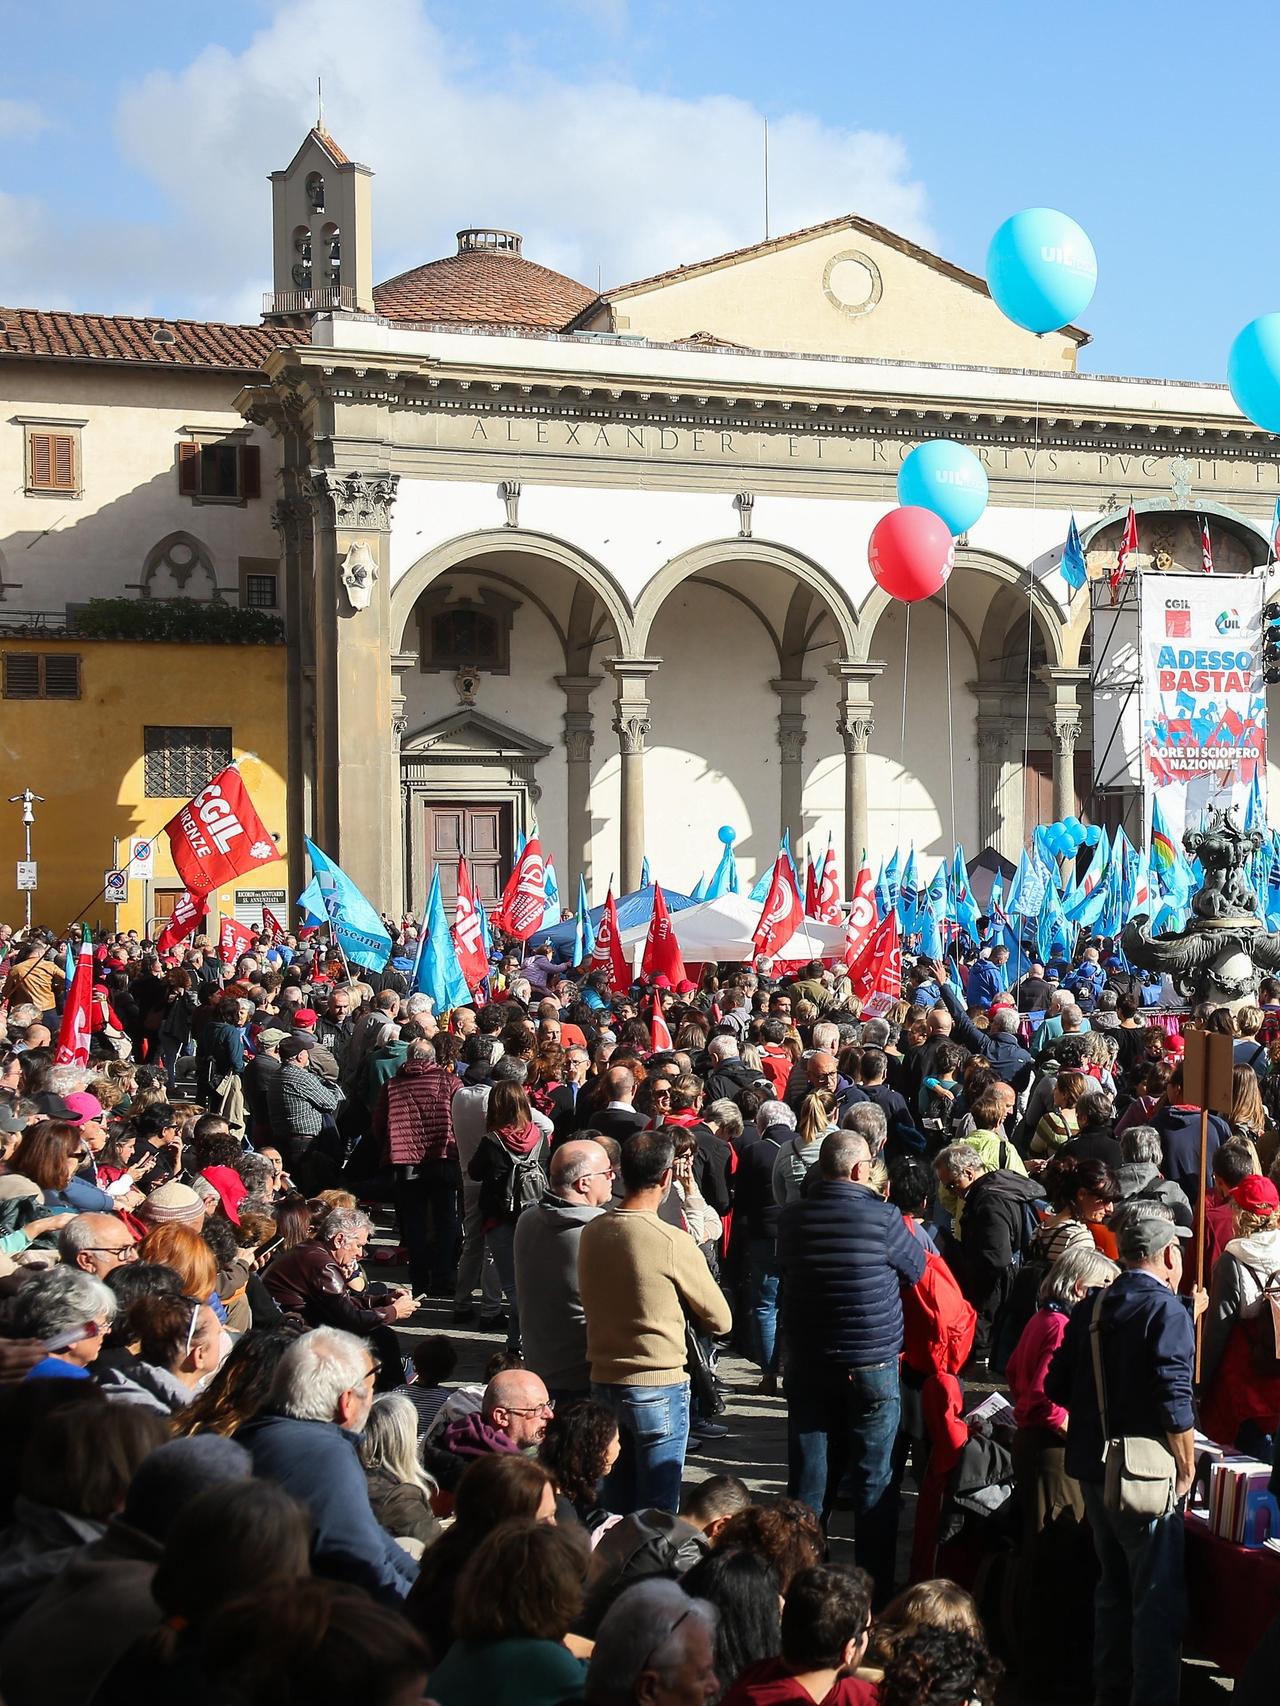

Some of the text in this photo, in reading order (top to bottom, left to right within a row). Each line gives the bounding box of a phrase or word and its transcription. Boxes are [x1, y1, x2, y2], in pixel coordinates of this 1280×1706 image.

[471, 418, 738, 454] ALEXANDER
[788, 436, 828, 460] ET
[1098, 454, 1217, 482] PVCII
[1164, 598, 1191, 610] CGIL
[1224, 620, 1241, 630] UIL
[1157, 645, 1251, 671] ADESSO
[1159, 670, 1250, 693] BASTA!
[1159, 747, 1185, 758] ORE
[1186, 747, 1200, 758] DI
[1201, 747, 1260, 759] SCIOPERO
[1170, 758, 1239, 770] NAZIONALE
[193, 784, 244, 855] CGIL
[332, 921, 381, 950] Toscana
